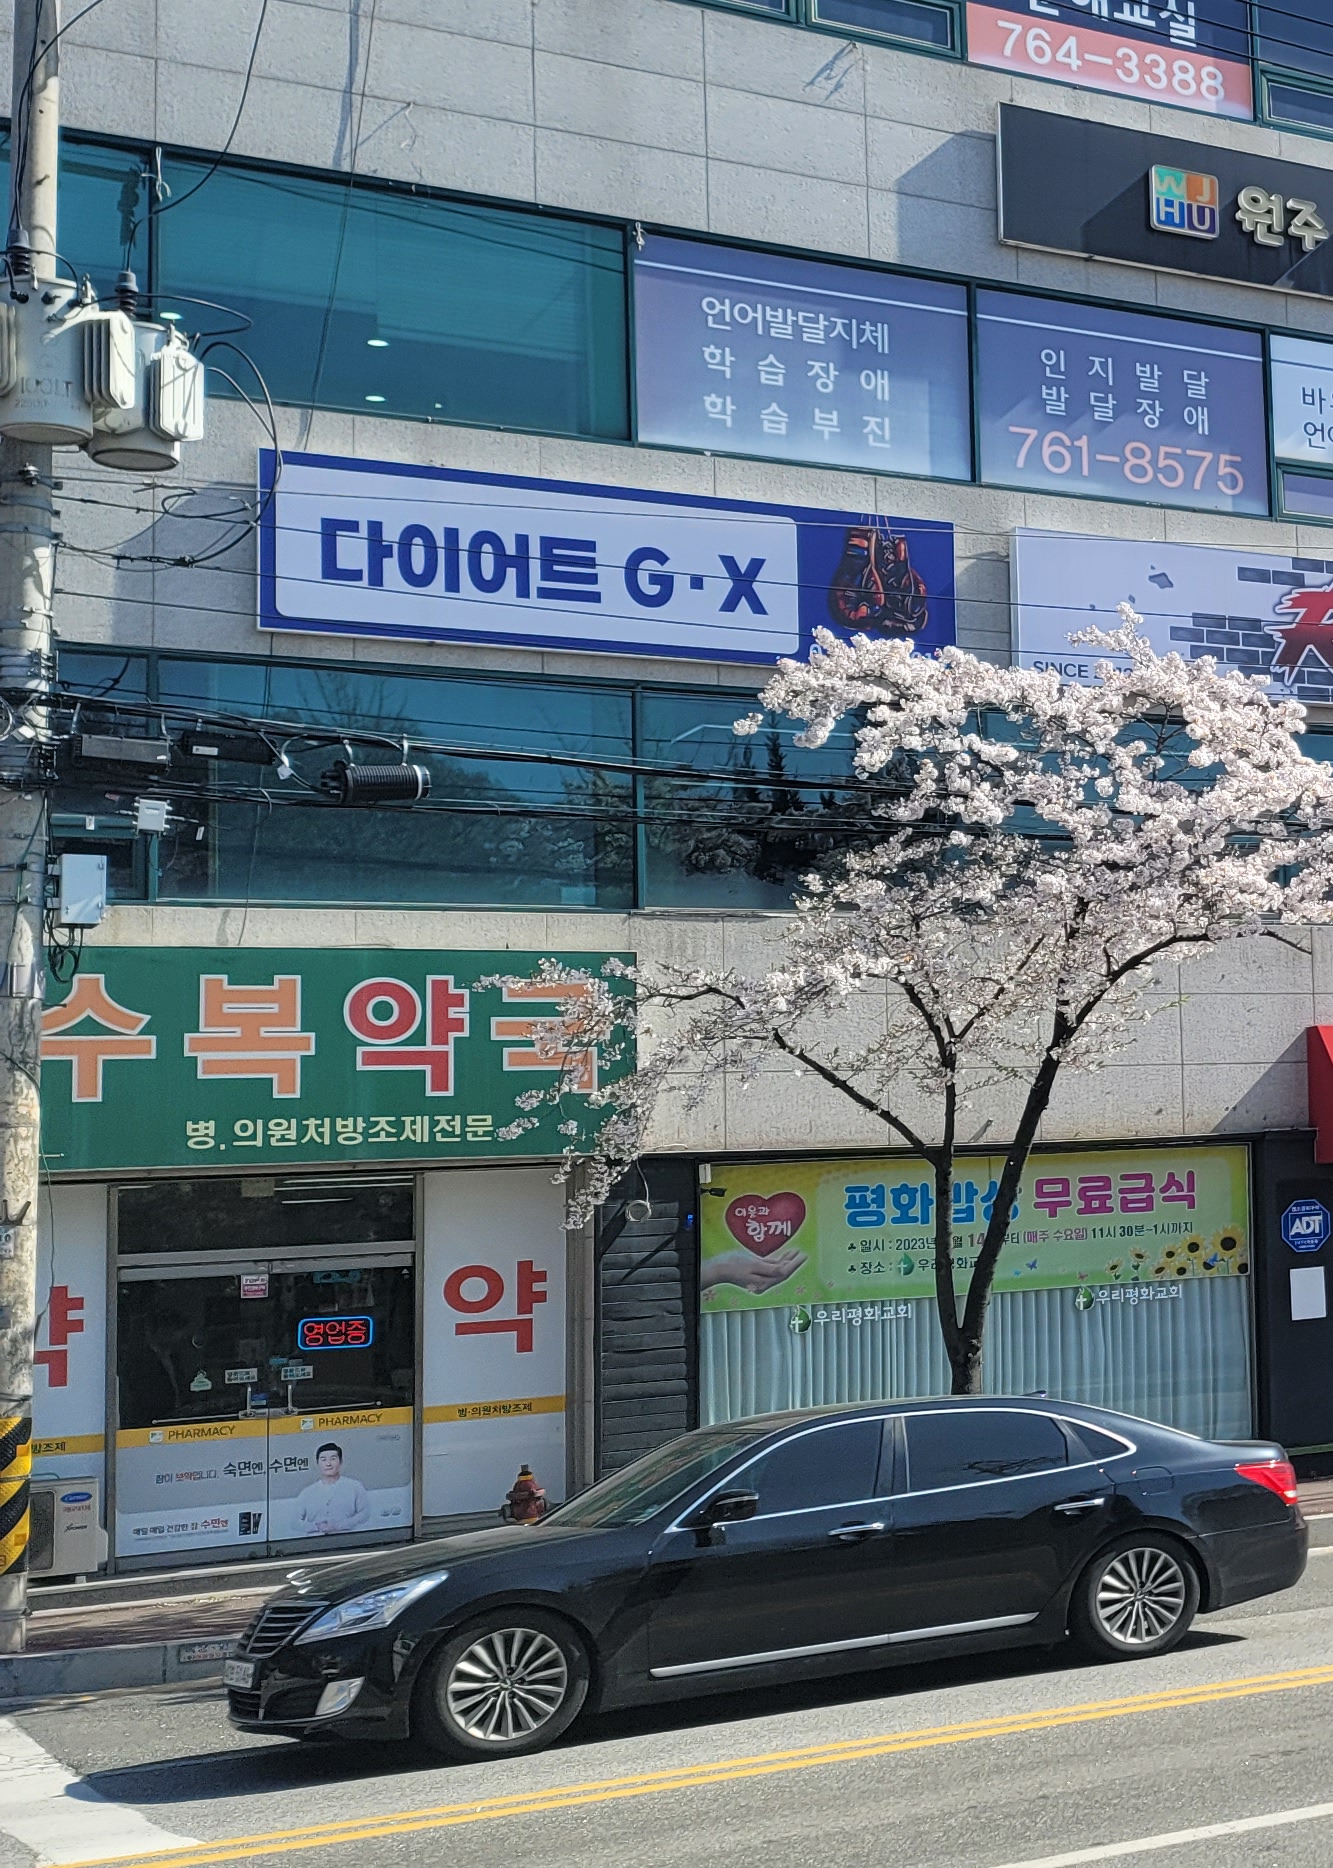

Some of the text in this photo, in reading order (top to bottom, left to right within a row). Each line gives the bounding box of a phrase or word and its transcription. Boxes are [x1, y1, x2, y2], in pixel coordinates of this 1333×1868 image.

[1029, 0, 1198, 48] 교실
[996, 19, 1226, 102] 764-3388
[1236, 186, 1329, 252] 원주
[701, 296, 890, 357] 언어발달지체
[702, 343, 891, 402] 학습장애
[1039, 349, 1210, 402] 인지발달
[703, 391, 893, 450] 학습부진
[1040, 383, 1210, 437] 발달장애
[1008, 426, 1245, 496] 761-8575
[321, 517, 602, 604] 다이어트
[1033, 660, 1089, 679] SINCE
[40, 973, 612, 1103] 수복약국
[185, 1114, 496, 1152] 병.의원처방조제전문
[1032, 1169, 1197, 1219] 무료급식
[746, 1220, 792, 1243] 함께
[859, 1238, 885, 1252] 일시
[1290, 1215, 1323, 1236] ADT
[859, 1261, 885, 1275] 장소
[443, 1259, 548, 1354] 약
[814, 1303, 912, 1327] 우리평화교회
[1096, 1284, 1183, 1305] 우리평화교회
[303, 1319, 368, 1346] 영업중
[168, 1425, 236, 1441] PHARMACY
[318, 1412, 383, 1428] PHARMACY
[269, 1456, 309, 1474] 수면엔
